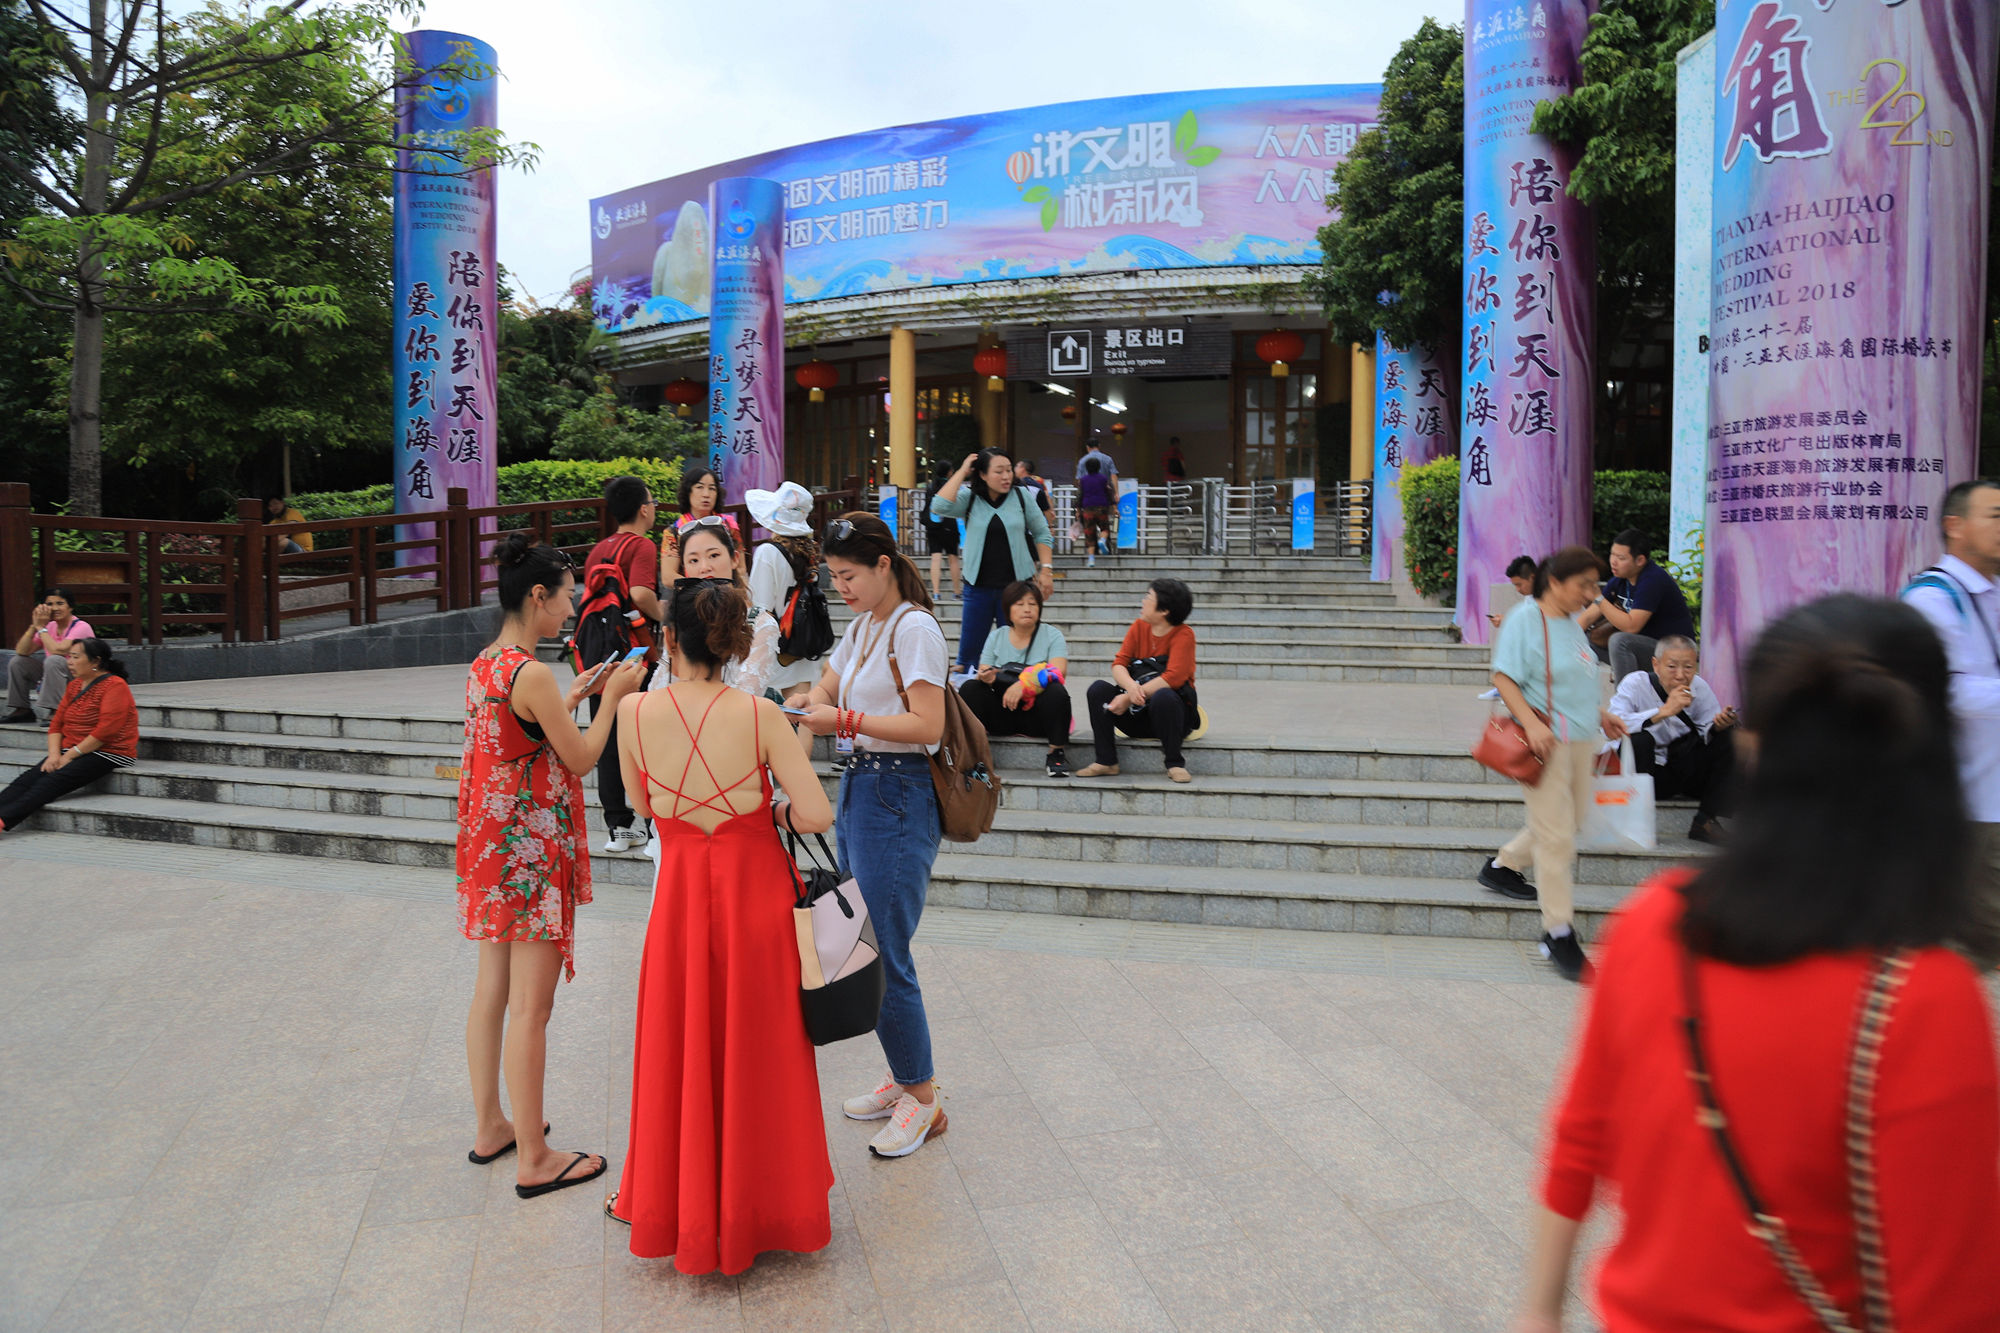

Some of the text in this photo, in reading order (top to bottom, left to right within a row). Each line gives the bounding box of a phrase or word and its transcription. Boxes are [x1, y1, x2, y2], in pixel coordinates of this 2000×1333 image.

[1722, 1, 1834, 172] 角
[1826, 87, 1867, 107] THE
[1030, 121, 1176, 179] 讲文明
[784, 155, 949, 210] 因文明而精彩
[784, 199, 949, 249] 因文明而魅力
[1714, 193, 1896, 249] TIANYA-HAIJIAO
[1714, 227, 1881, 276] INTERNATIONAL
[1508, 157, 1561, 437] 陪你到天涯
[1714, 262, 1793, 299] WEDDING
[1714, 281, 1856, 324] FESTIVAL 2018
[447, 250, 485, 464] 陪你到天涯
[1103, 328, 1184, 349] 景区出口
[1103, 350, 1128, 359] Exit
[1466, 211, 1502, 487] 爱你到海角
[404, 281, 441, 500] 爱你到海角
[733, 328, 763, 455] 寻梦天涯
[1382, 335, 1409, 468] 爱海角
[1722, 433, 1902, 458] 三亚市文化广电出版体育局
[1720, 505, 1930, 524] 三亚蓝色联盟会展策划有限公司
